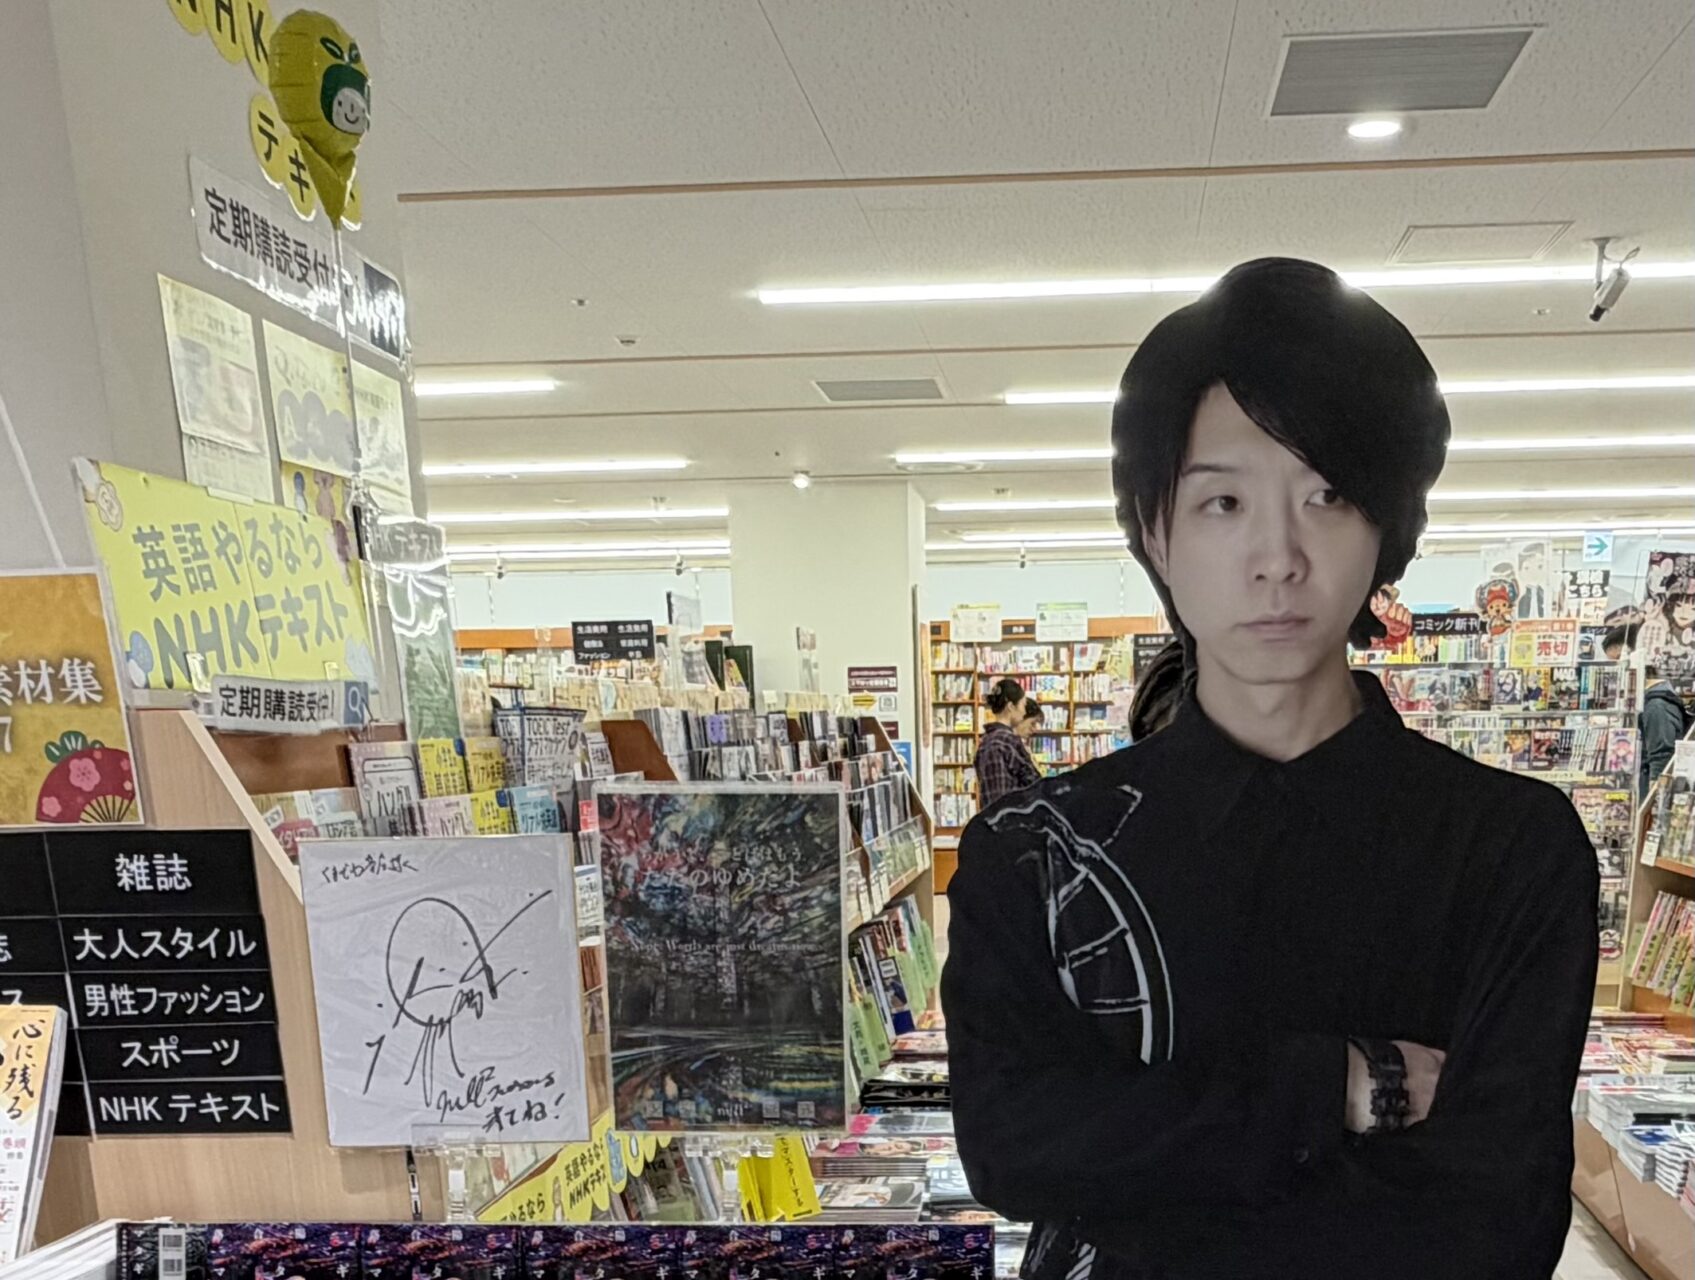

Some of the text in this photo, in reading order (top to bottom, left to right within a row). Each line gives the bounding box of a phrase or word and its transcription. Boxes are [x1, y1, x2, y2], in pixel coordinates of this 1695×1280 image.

[132, 515, 324, 602] 英語やるなら
[1414, 617, 1480, 632] コミック新刊
[1536, 641, 1568, 656] 売切
[0, 658, 103, 706] 材集
[115, 853, 193, 892] 雑誌
[73, 927, 256, 961] 大人スタイル
[84, 985, 265, 1017] 男性ファッション
[121, 1037, 240, 1069] スポーツ
[3, 1020, 46, 1121] 心に残る
[100, 1092, 281, 1123] NHK テキスト
